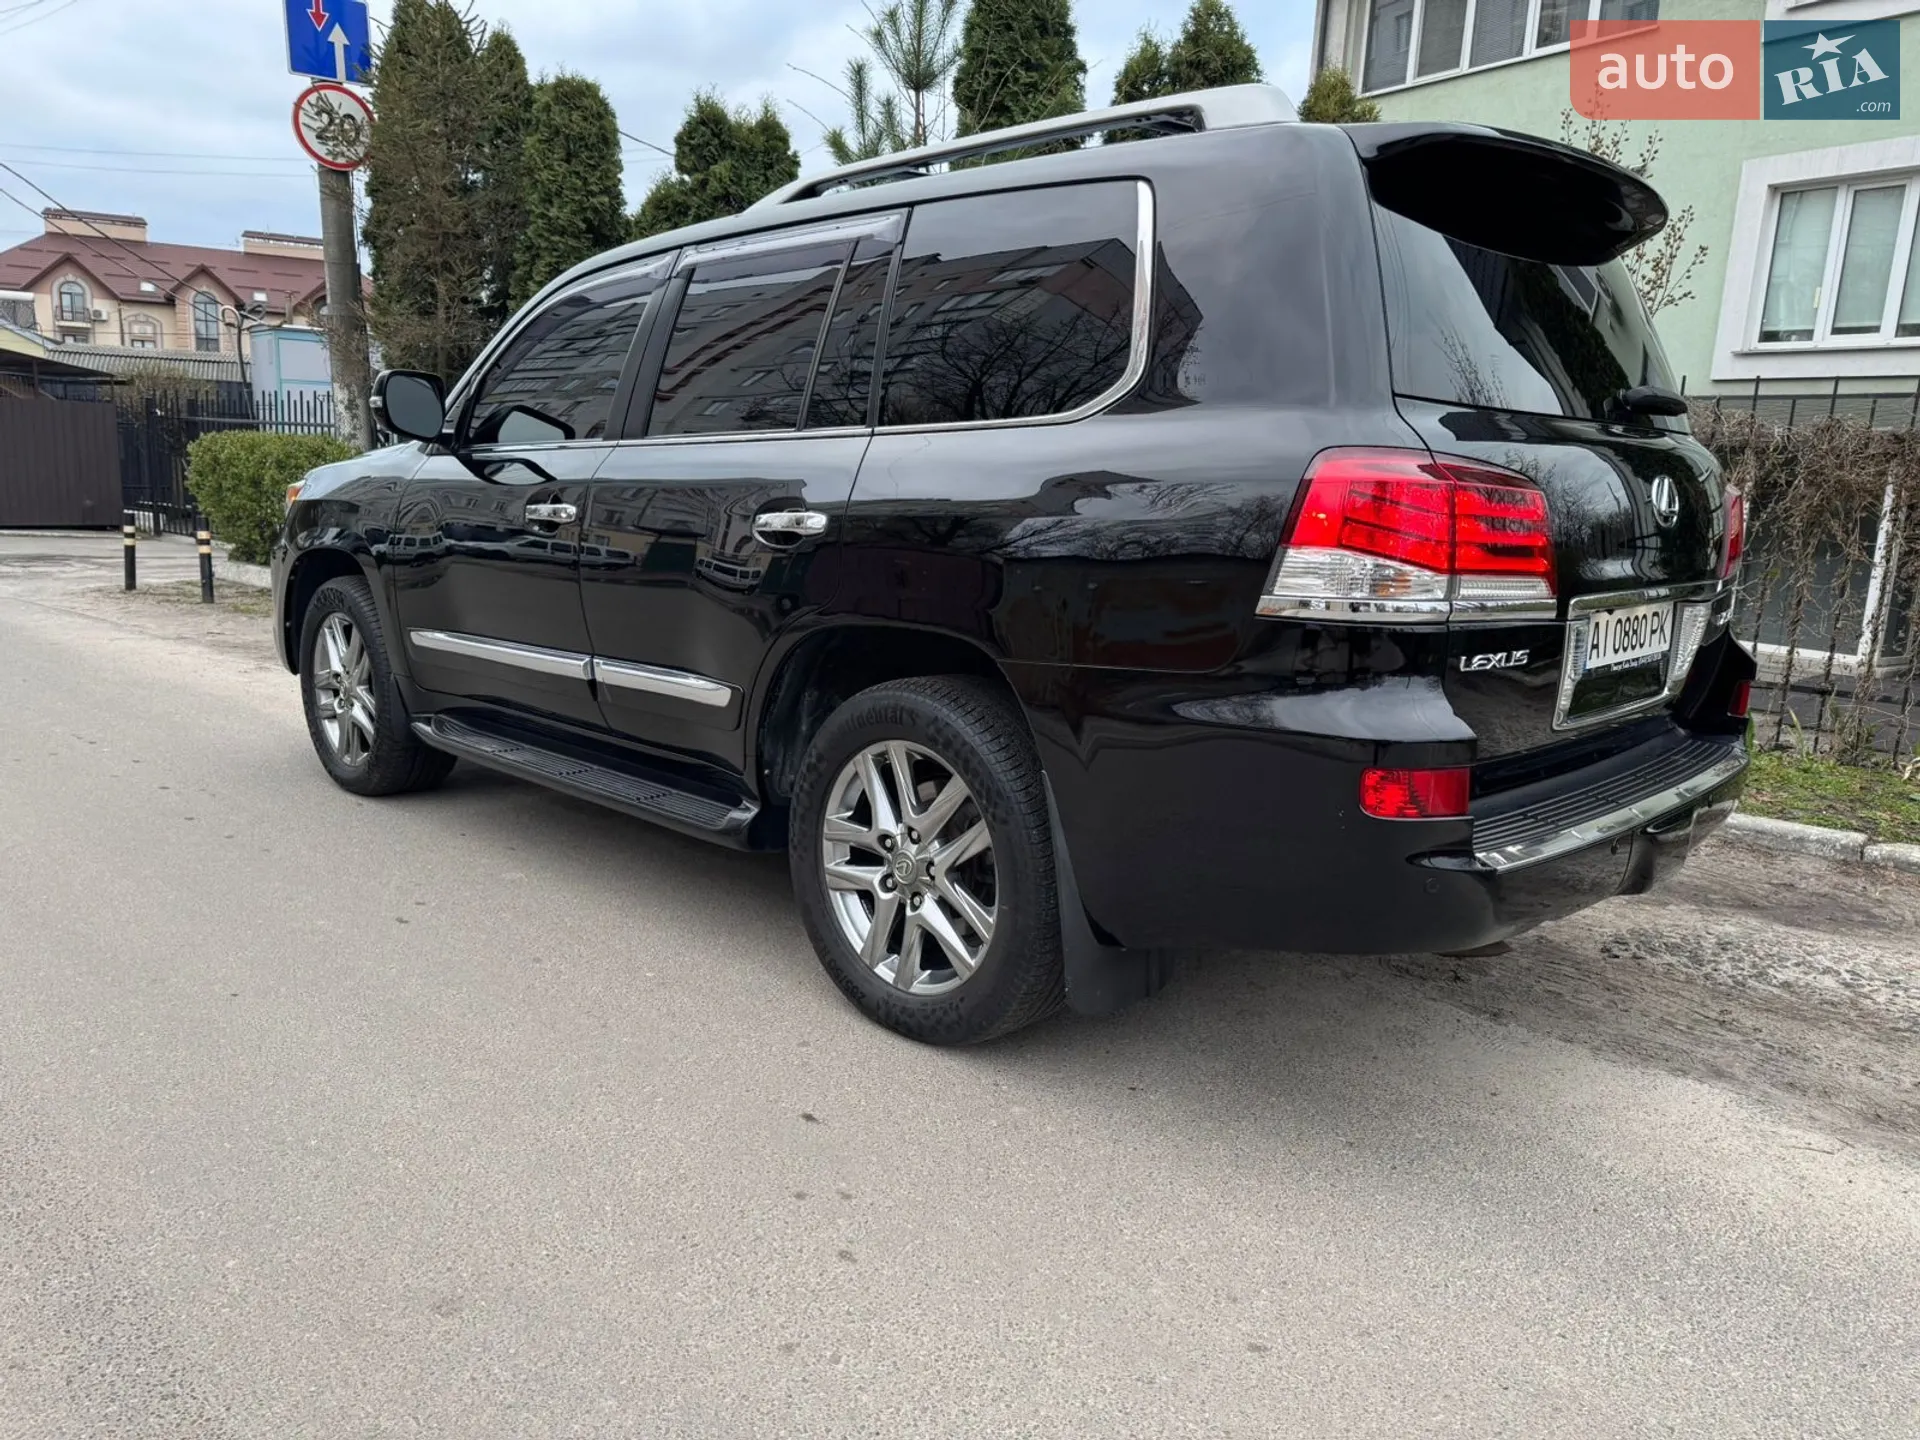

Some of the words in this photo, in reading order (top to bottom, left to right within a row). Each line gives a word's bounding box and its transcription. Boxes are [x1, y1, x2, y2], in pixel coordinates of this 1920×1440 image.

[1589, 619, 1609, 661] AI
[1612, 613, 1648, 655] 0880
[1649, 609, 1670, 648] PK
[1460, 649, 1530, 672] LEXUS
